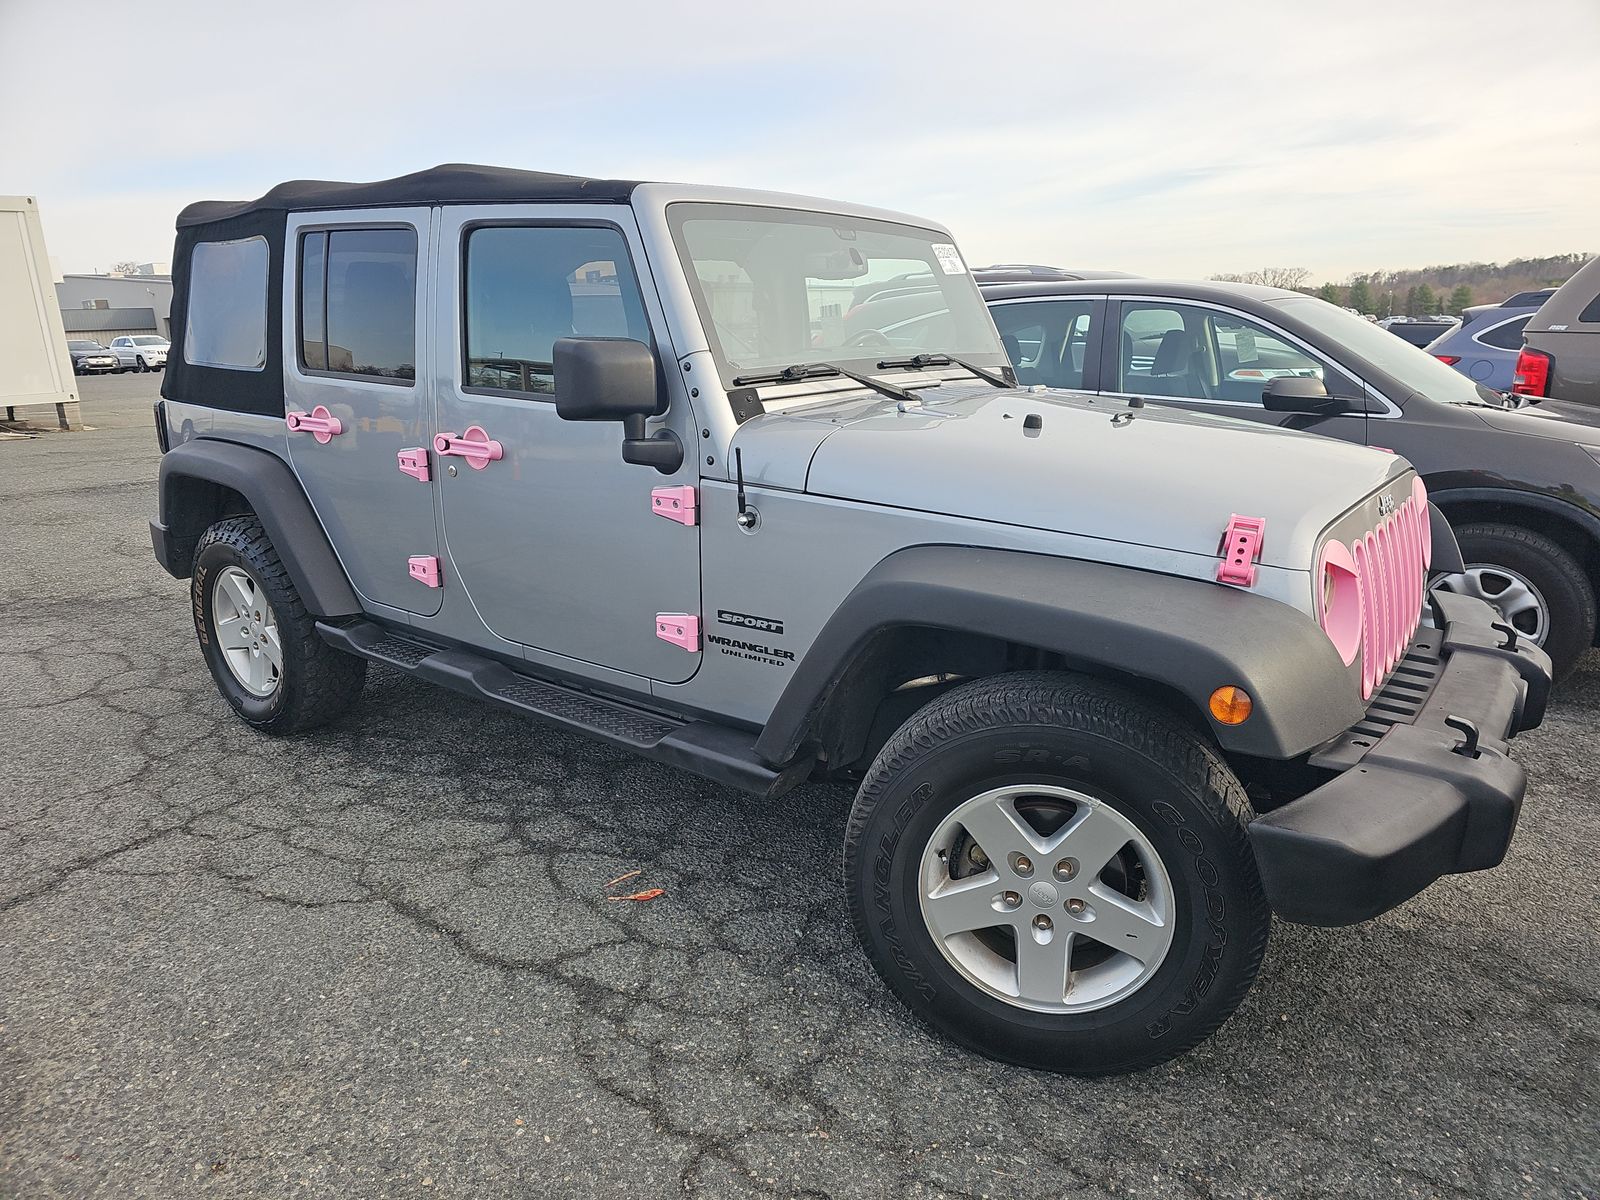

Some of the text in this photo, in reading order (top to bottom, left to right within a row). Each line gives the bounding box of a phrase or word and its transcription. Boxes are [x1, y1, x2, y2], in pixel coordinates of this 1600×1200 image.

[195, 566, 209, 645] GENERAL
[719, 612, 783, 632] SPORT
[707, 634, 796, 661] WRANGLER
[721, 648, 785, 667] UNLIMITED
[873, 781, 938, 1002] WRANGLER
[1145, 800, 1229, 1040] GOODYEAR
